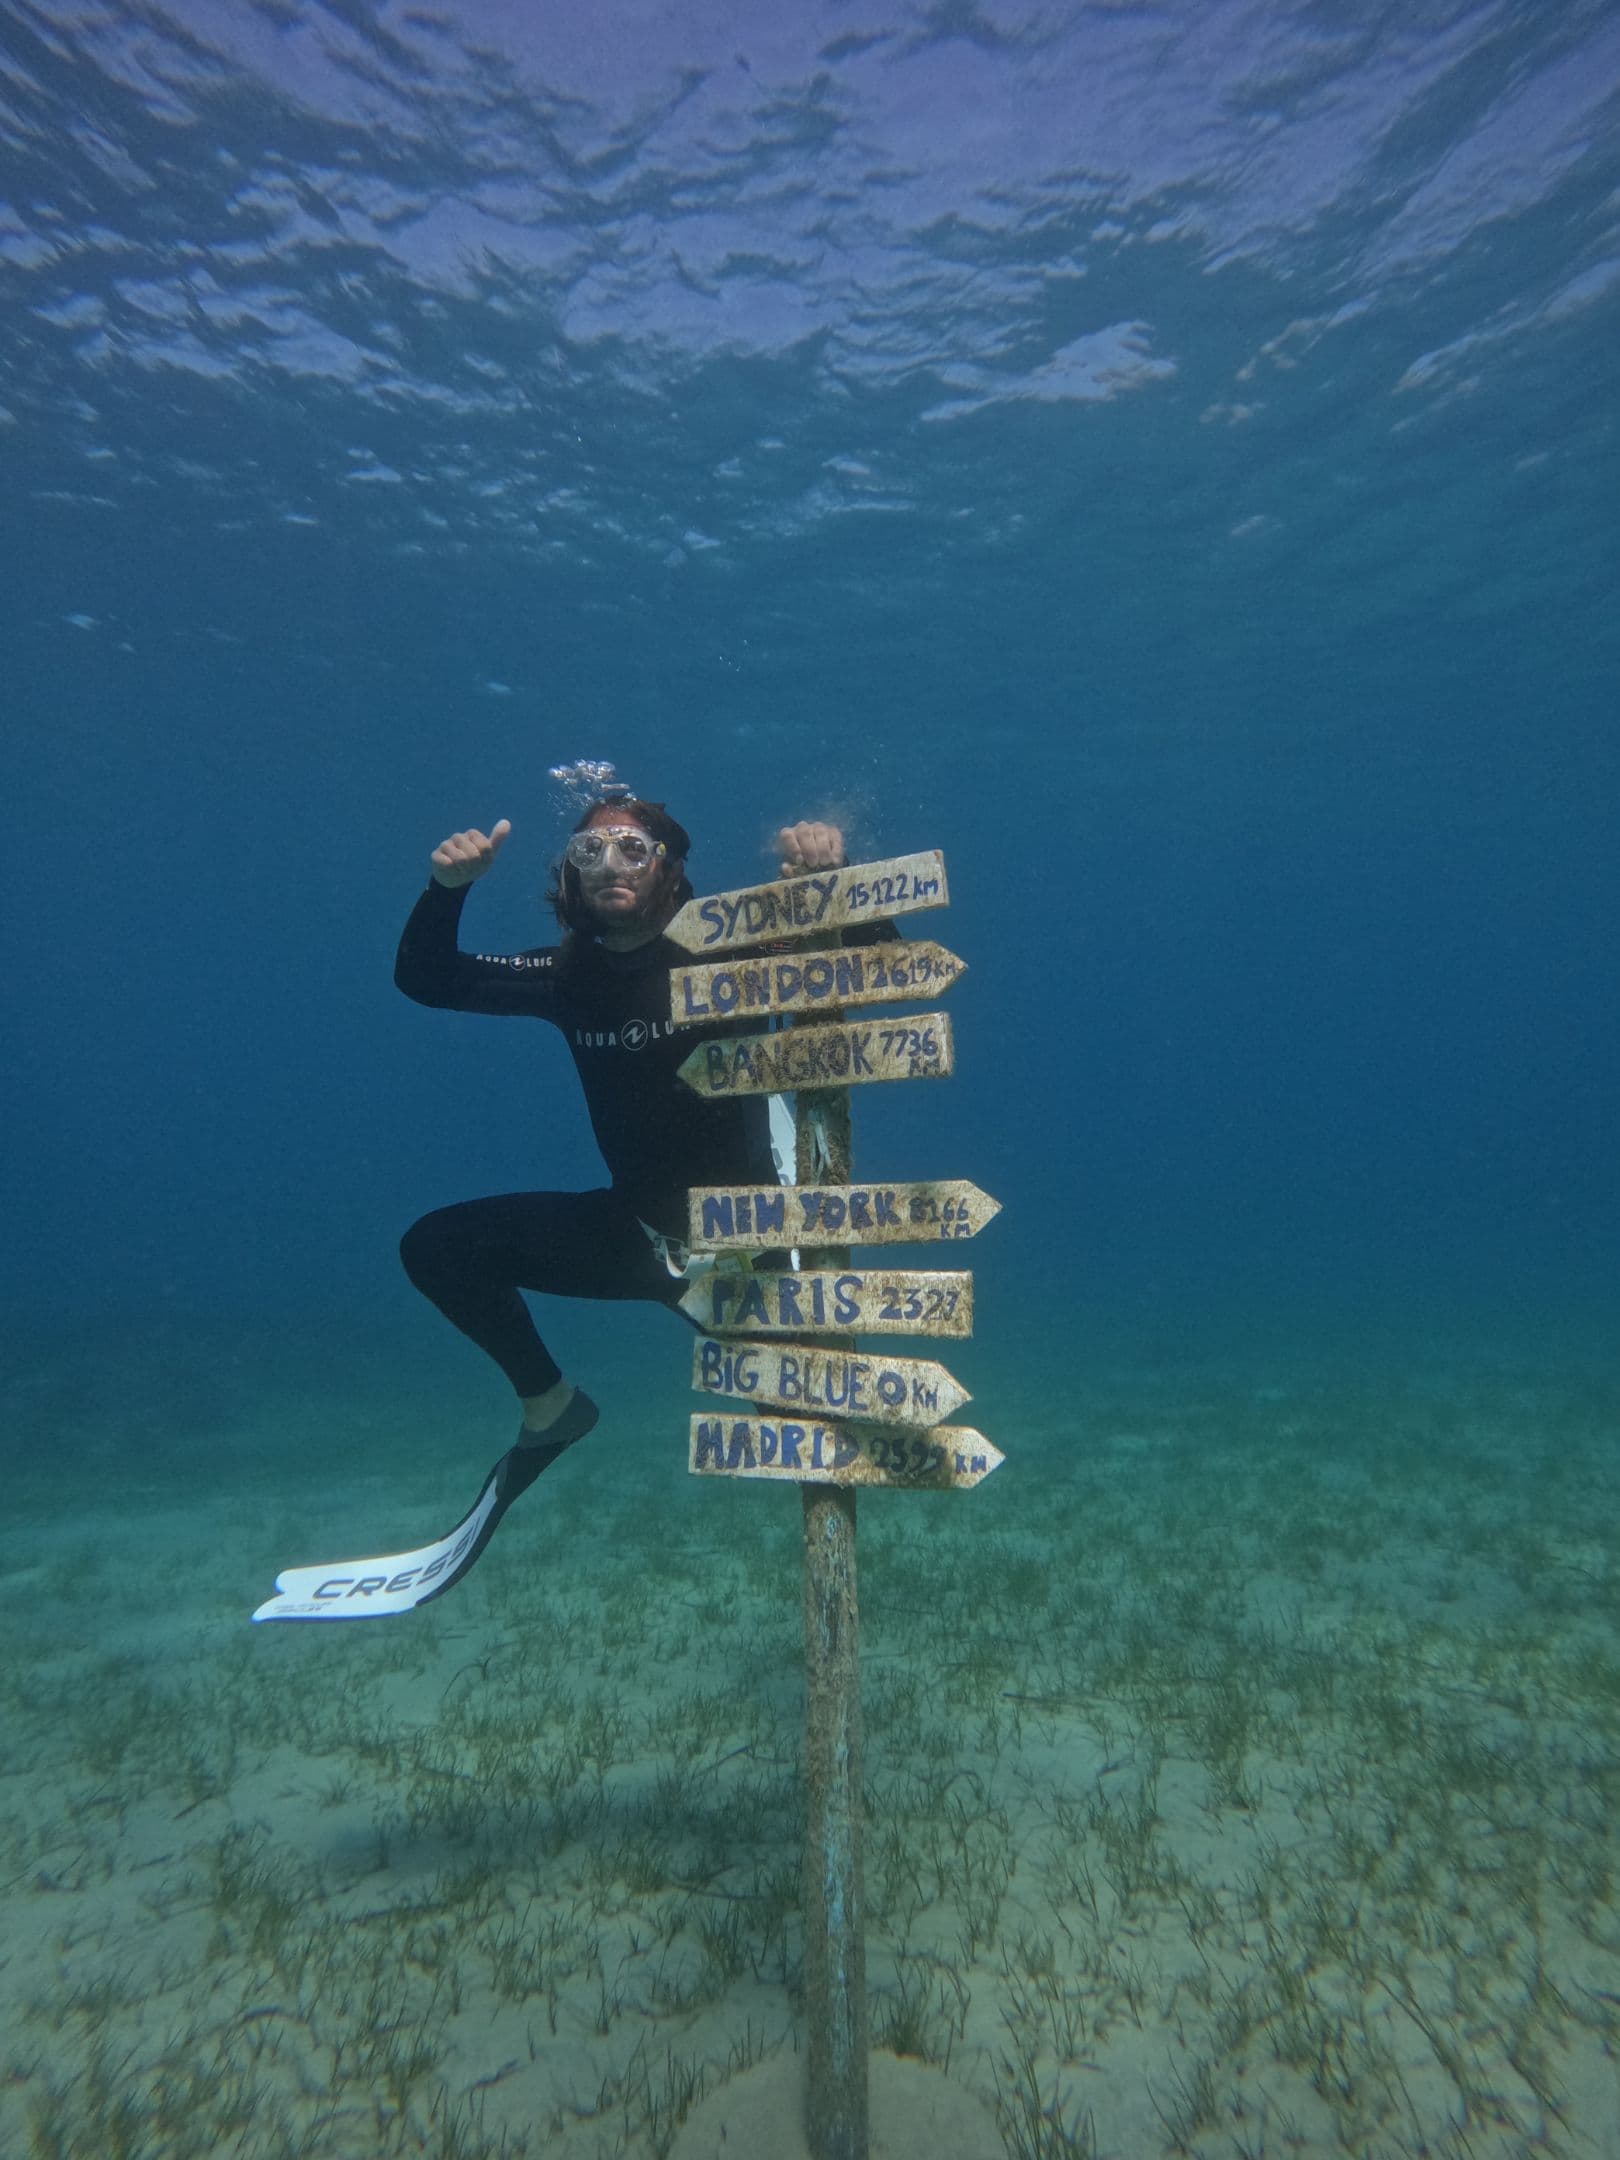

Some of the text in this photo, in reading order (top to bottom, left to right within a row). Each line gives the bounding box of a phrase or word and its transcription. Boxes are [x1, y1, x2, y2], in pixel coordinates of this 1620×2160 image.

[700, 874, 839, 945] SYDNEY
[846, 874, 910, 910] 15122
[683, 955, 865, 1016] LONDON
[868, 954, 932, 989] 2619
[576, 1020, 691, 1048] AQUA LU
[706, 1027, 938, 1091] BANGKOK 7736
[702, 1193, 785, 1239] NEW
[799, 1191, 902, 1233] YORK
[940, 1223, 972, 1238] KM
[711, 1276, 864, 1326] PARIS
[778, 1357, 870, 1411] BLUE
[694, 1421, 859, 1470] MADRID
[955, 1453, 988, 1473] KM
